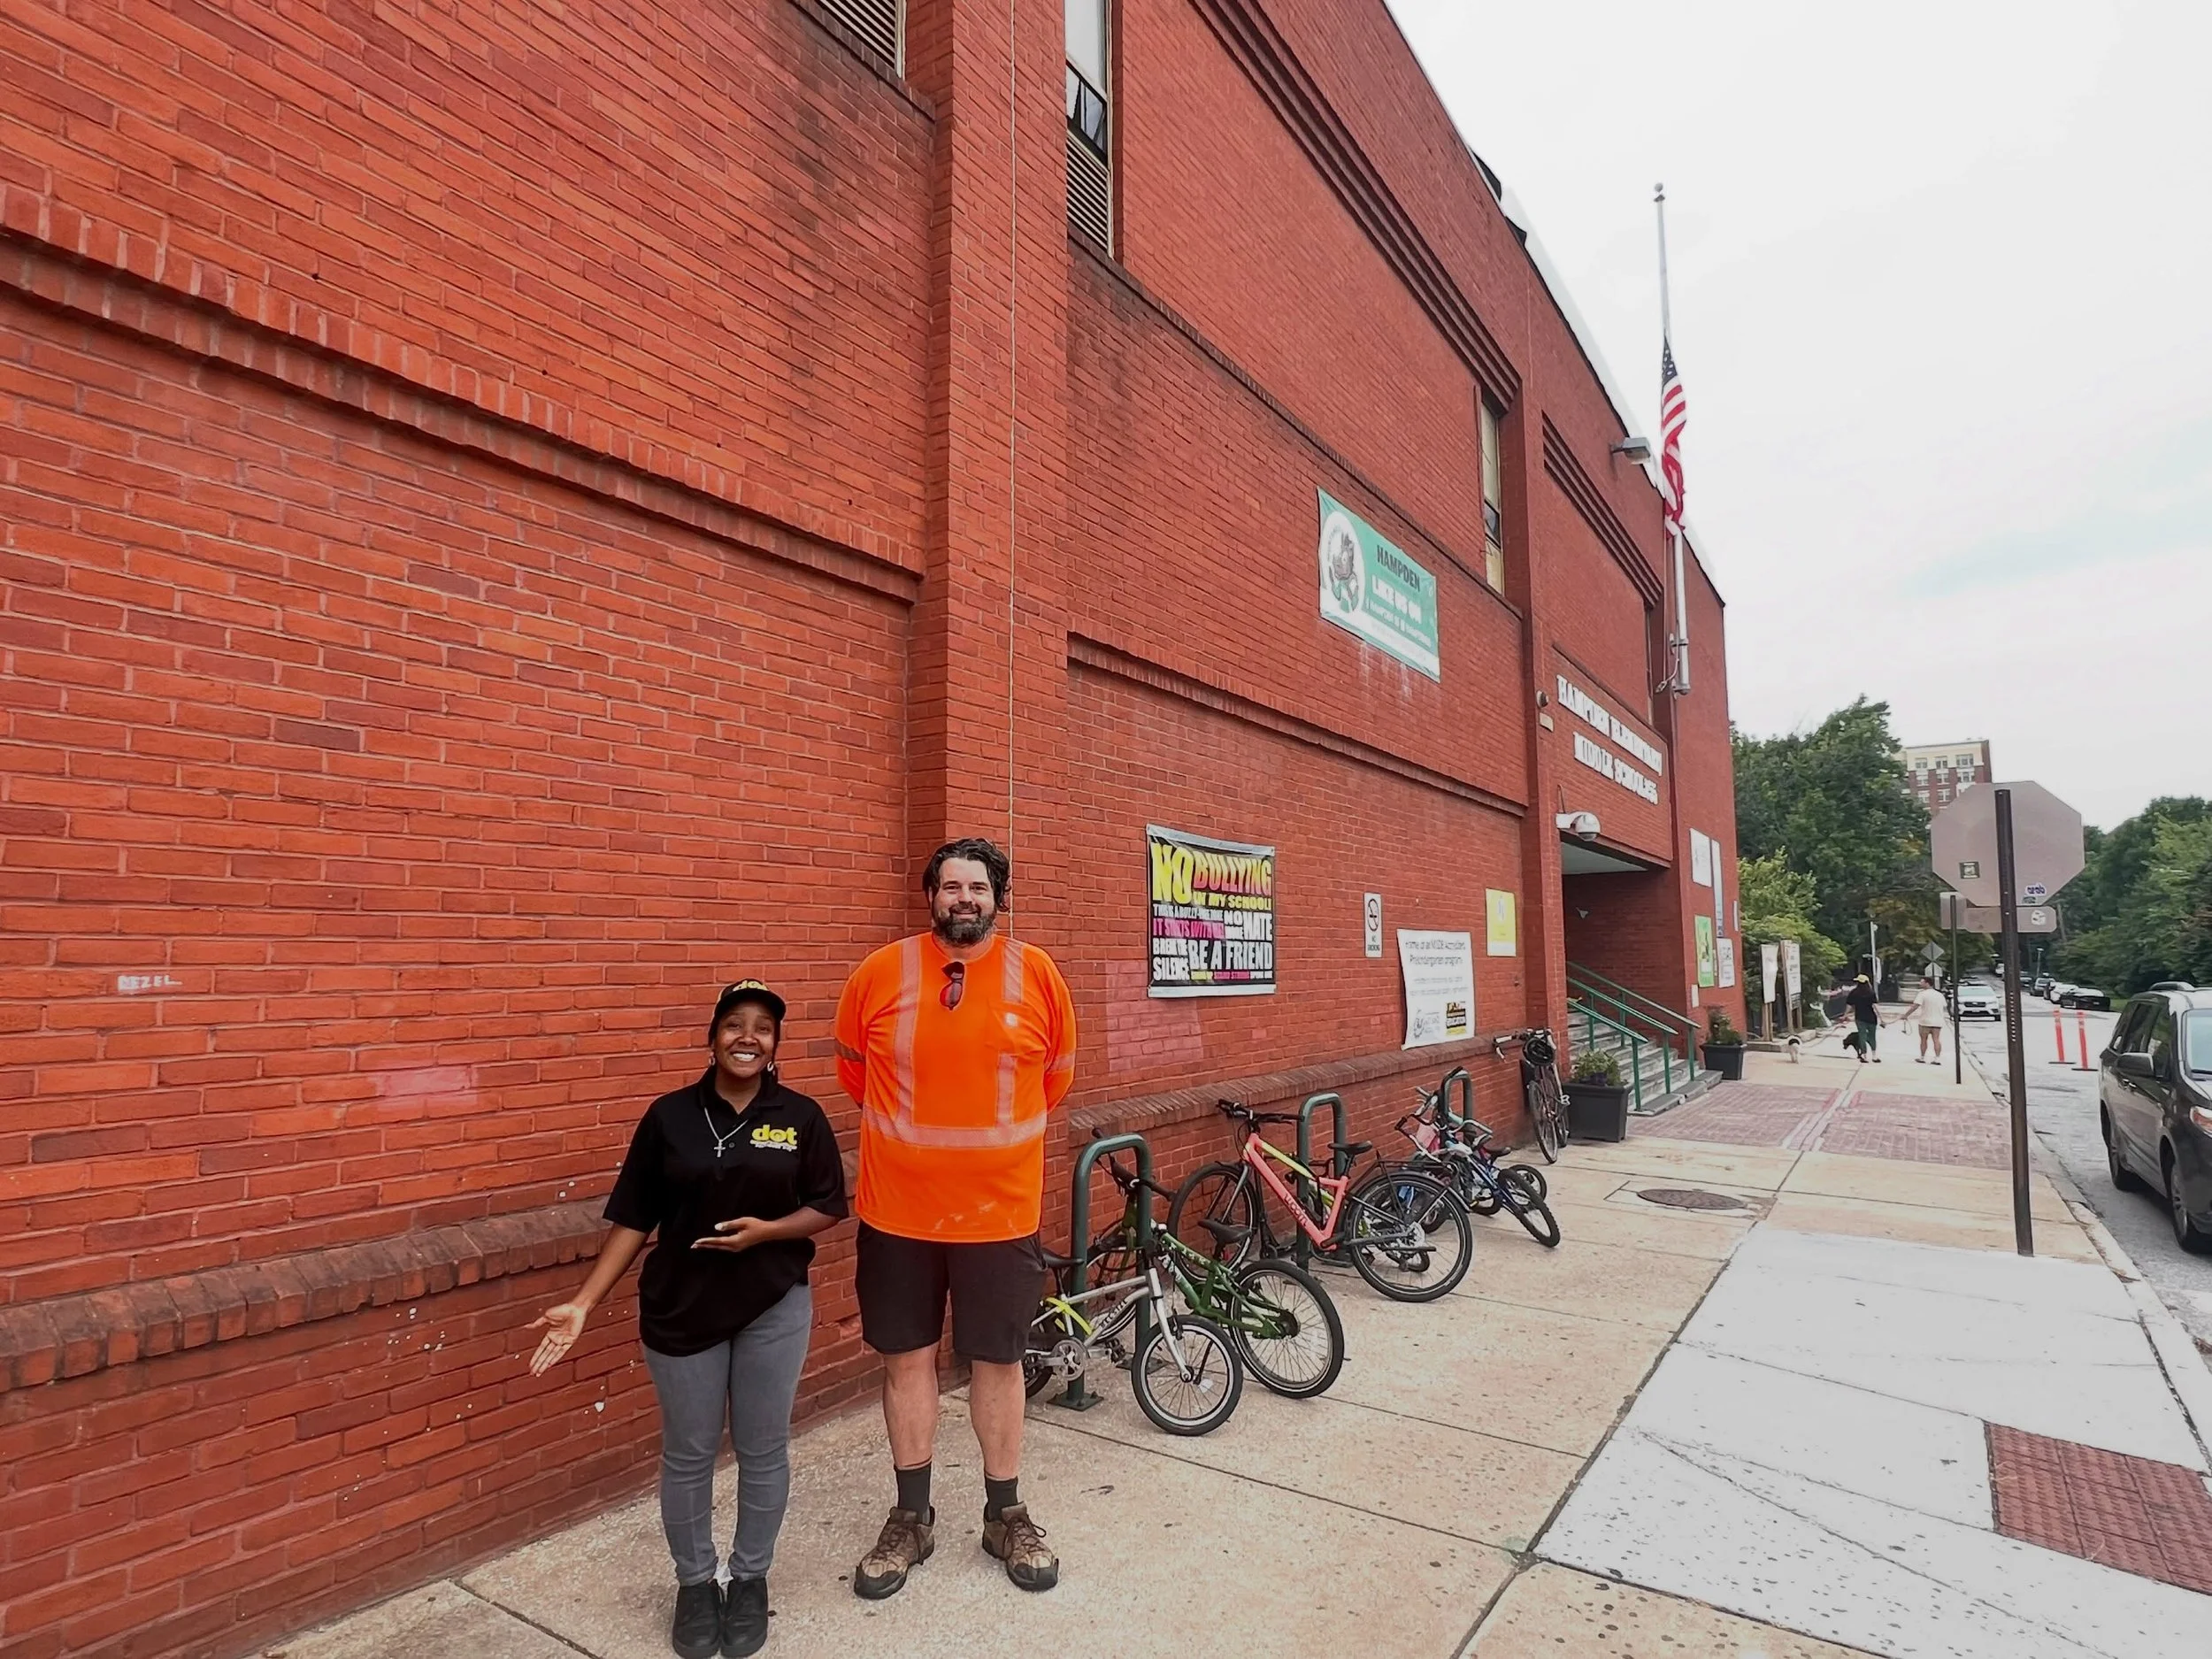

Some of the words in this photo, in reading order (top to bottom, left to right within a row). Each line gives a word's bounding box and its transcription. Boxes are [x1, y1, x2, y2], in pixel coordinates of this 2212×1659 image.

[1377, 545, 1420, 592] HAMPDEN
[1151, 842, 1194, 904] NO
[1192, 850, 1272, 896] BULLYING
[1188, 940, 1210, 971] BE
[1211, 941, 1223, 971] A
[1225, 940, 1273, 971] FRIEND
[752, 1124, 797, 1146] dot
